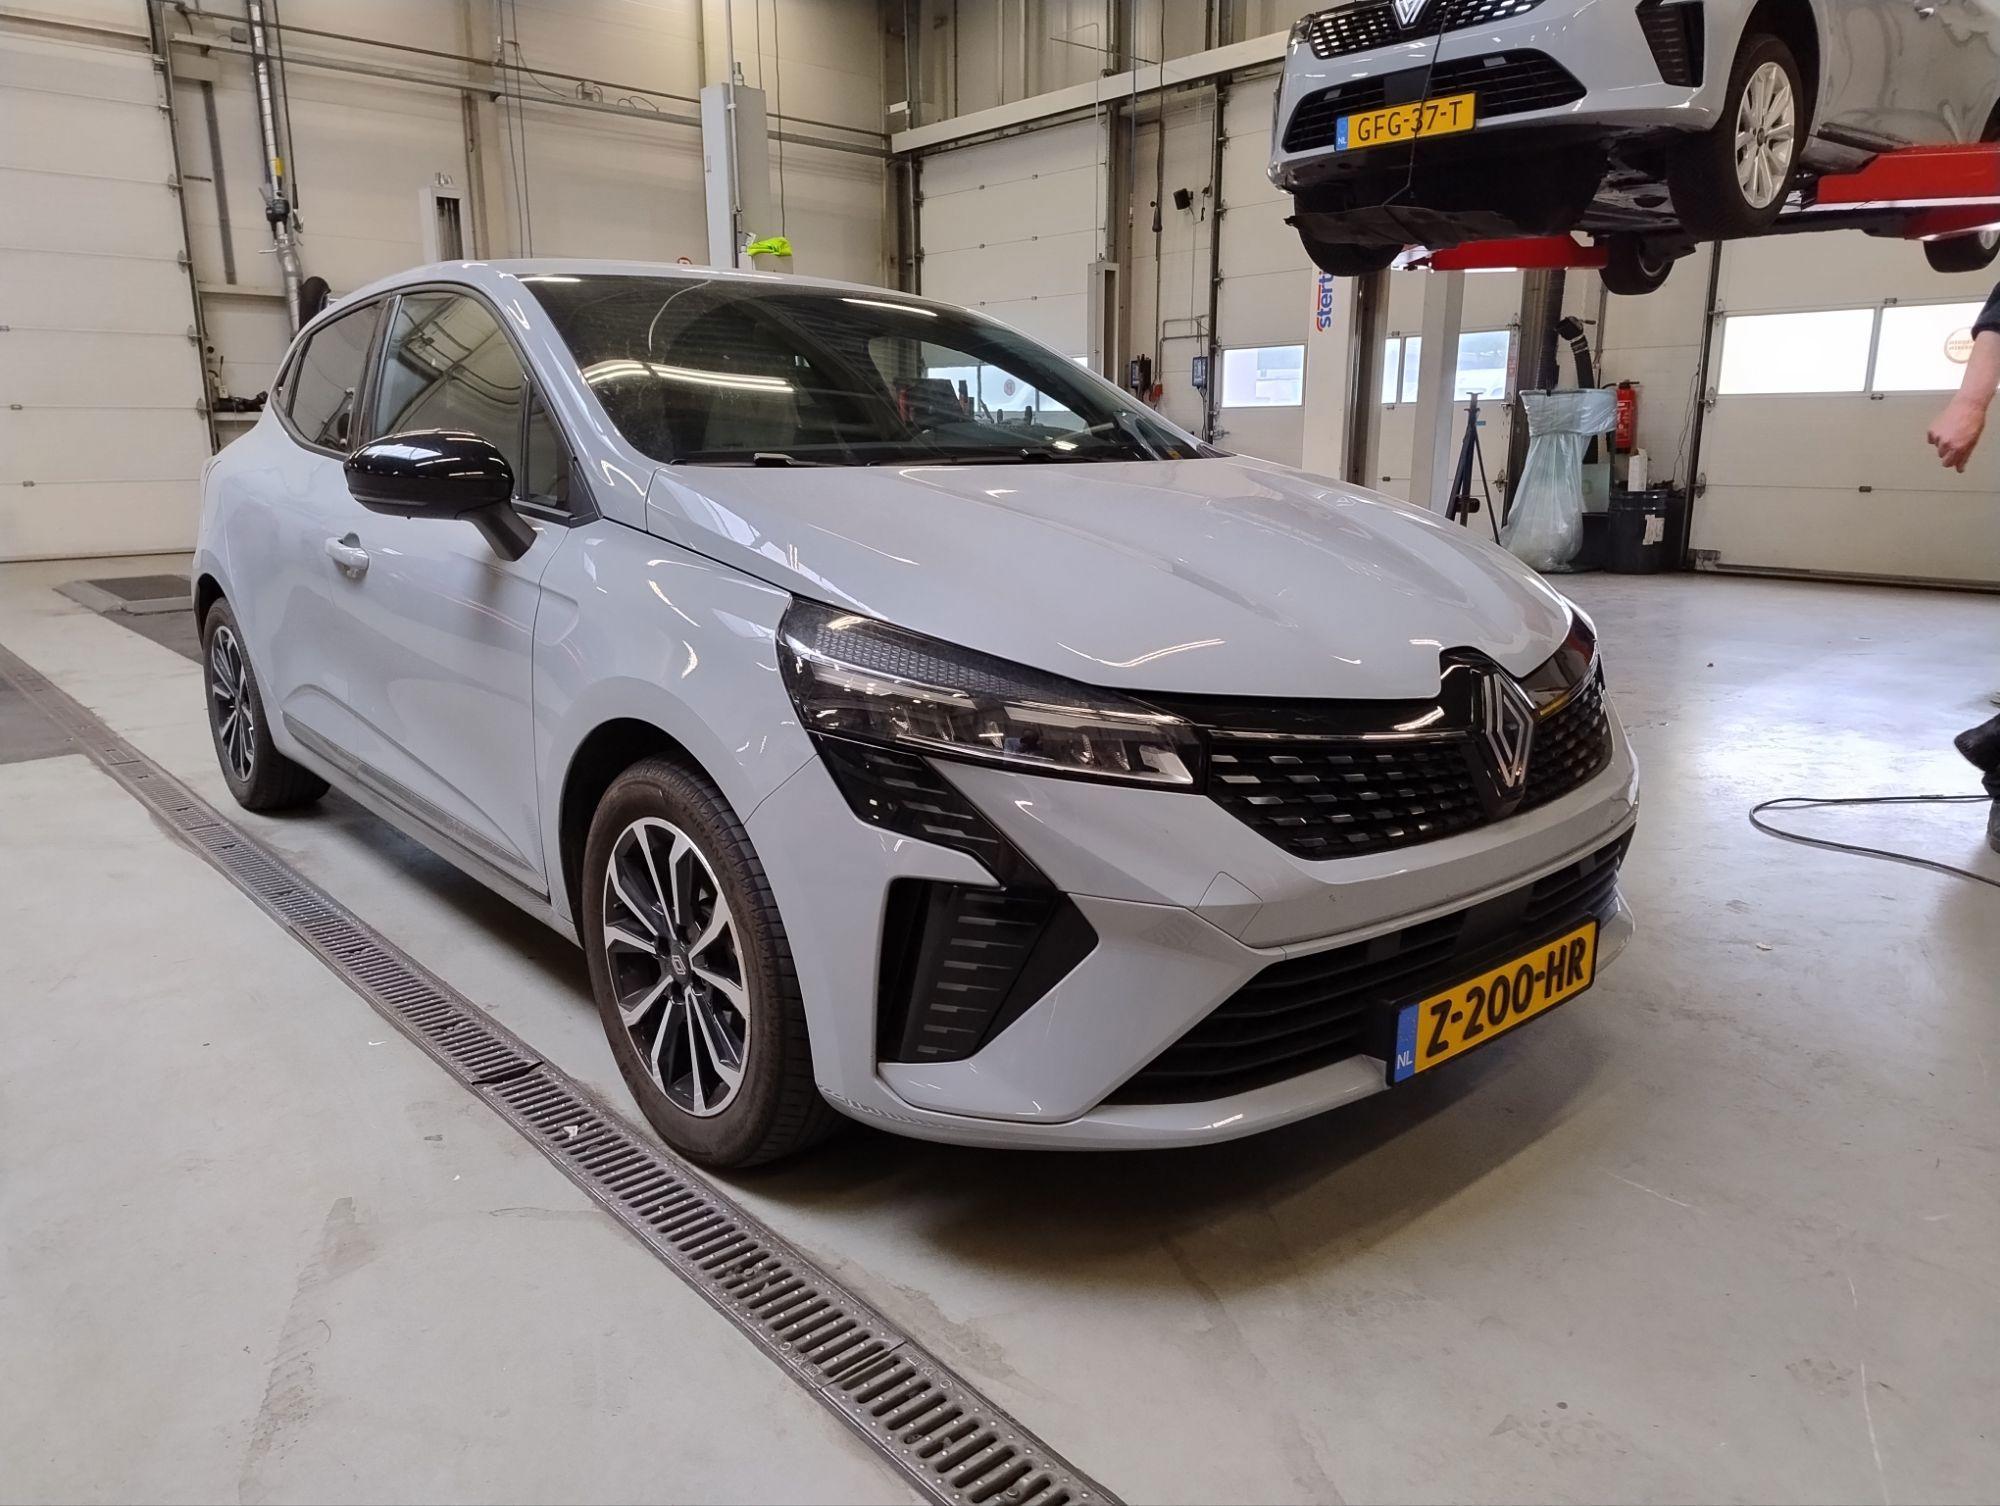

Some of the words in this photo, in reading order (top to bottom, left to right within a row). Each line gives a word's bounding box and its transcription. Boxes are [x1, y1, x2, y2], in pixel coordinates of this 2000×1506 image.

[1337, 136, 1347, 145] NL
[1357, 100, 1463, 142] GFG-37-T
[1316, 270, 1335, 330] stert
[1426, 936, 1586, 1058] Z-200-HR
[1396, 1050, 1413, 1070] NL
